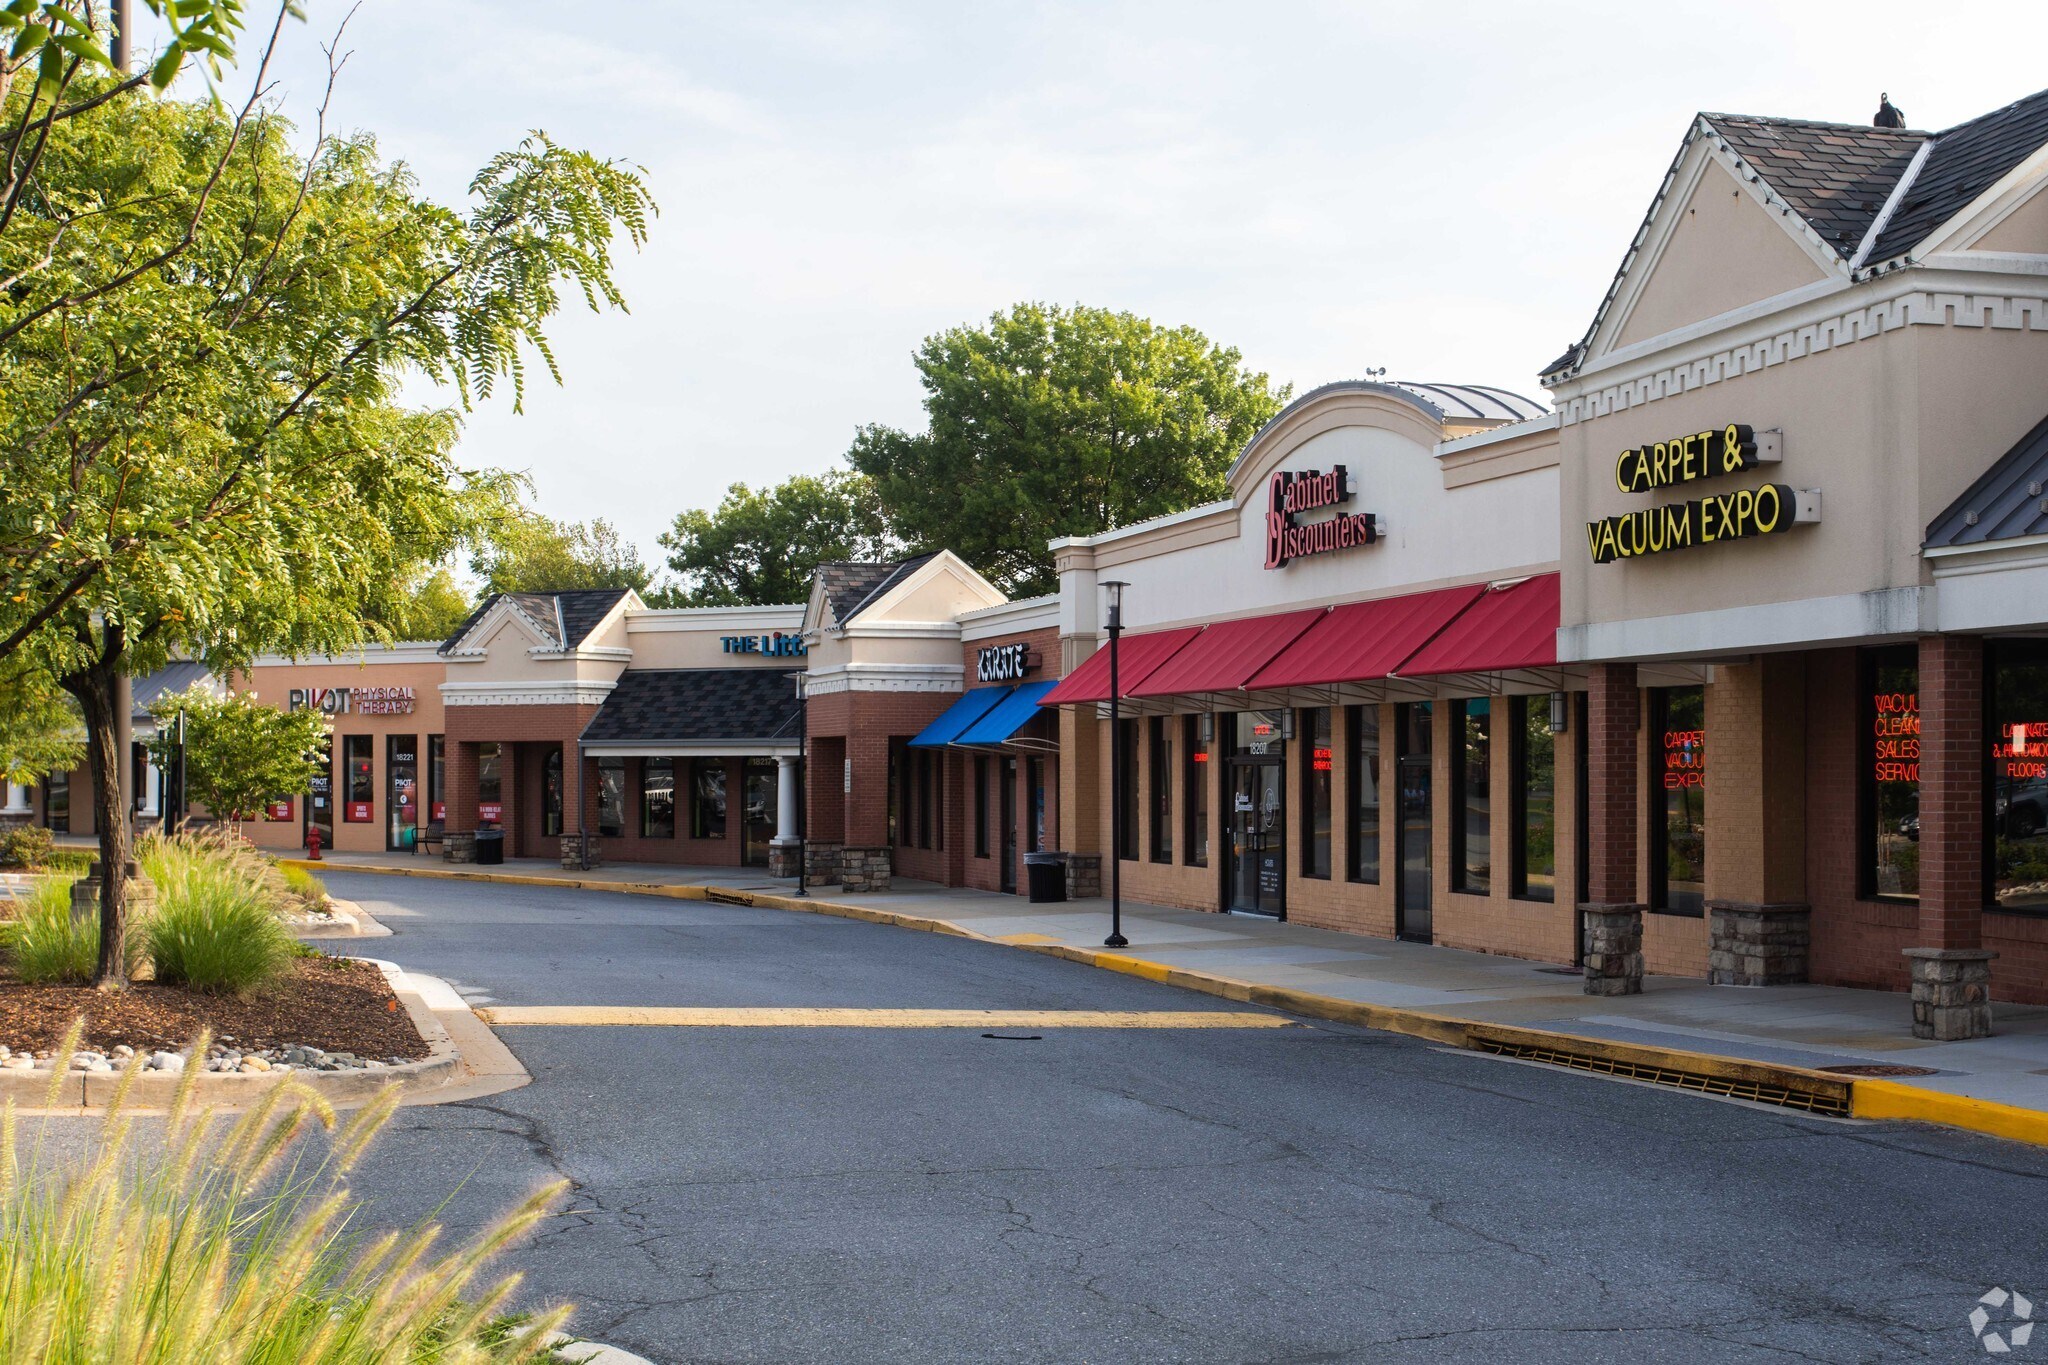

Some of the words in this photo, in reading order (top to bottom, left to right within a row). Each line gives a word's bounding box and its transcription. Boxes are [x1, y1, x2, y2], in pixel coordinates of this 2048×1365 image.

[1616, 430, 1712, 493] CARPET
[1723, 424, 1744, 473] &
[1269, 465, 1342, 539] Cabinet
[1586, 500, 1692, 563] VACUUM
[1701, 482, 1780, 543] EXPO
[1264, 511, 1367, 570] Discounters
[720, 636, 758, 653] THE
[977, 643, 1025, 682] KARATE
[289, 688, 350, 713] PIVOT
[353, 687, 413, 700] PHYSICAL
[355, 701, 410, 714] THERAPY
[396, 753, 414, 761] 18221
[1249, 742, 1267, 755] 18207
[1875, 740, 1920, 759] SALES
[2007, 763, 2047, 779] FLOORS
